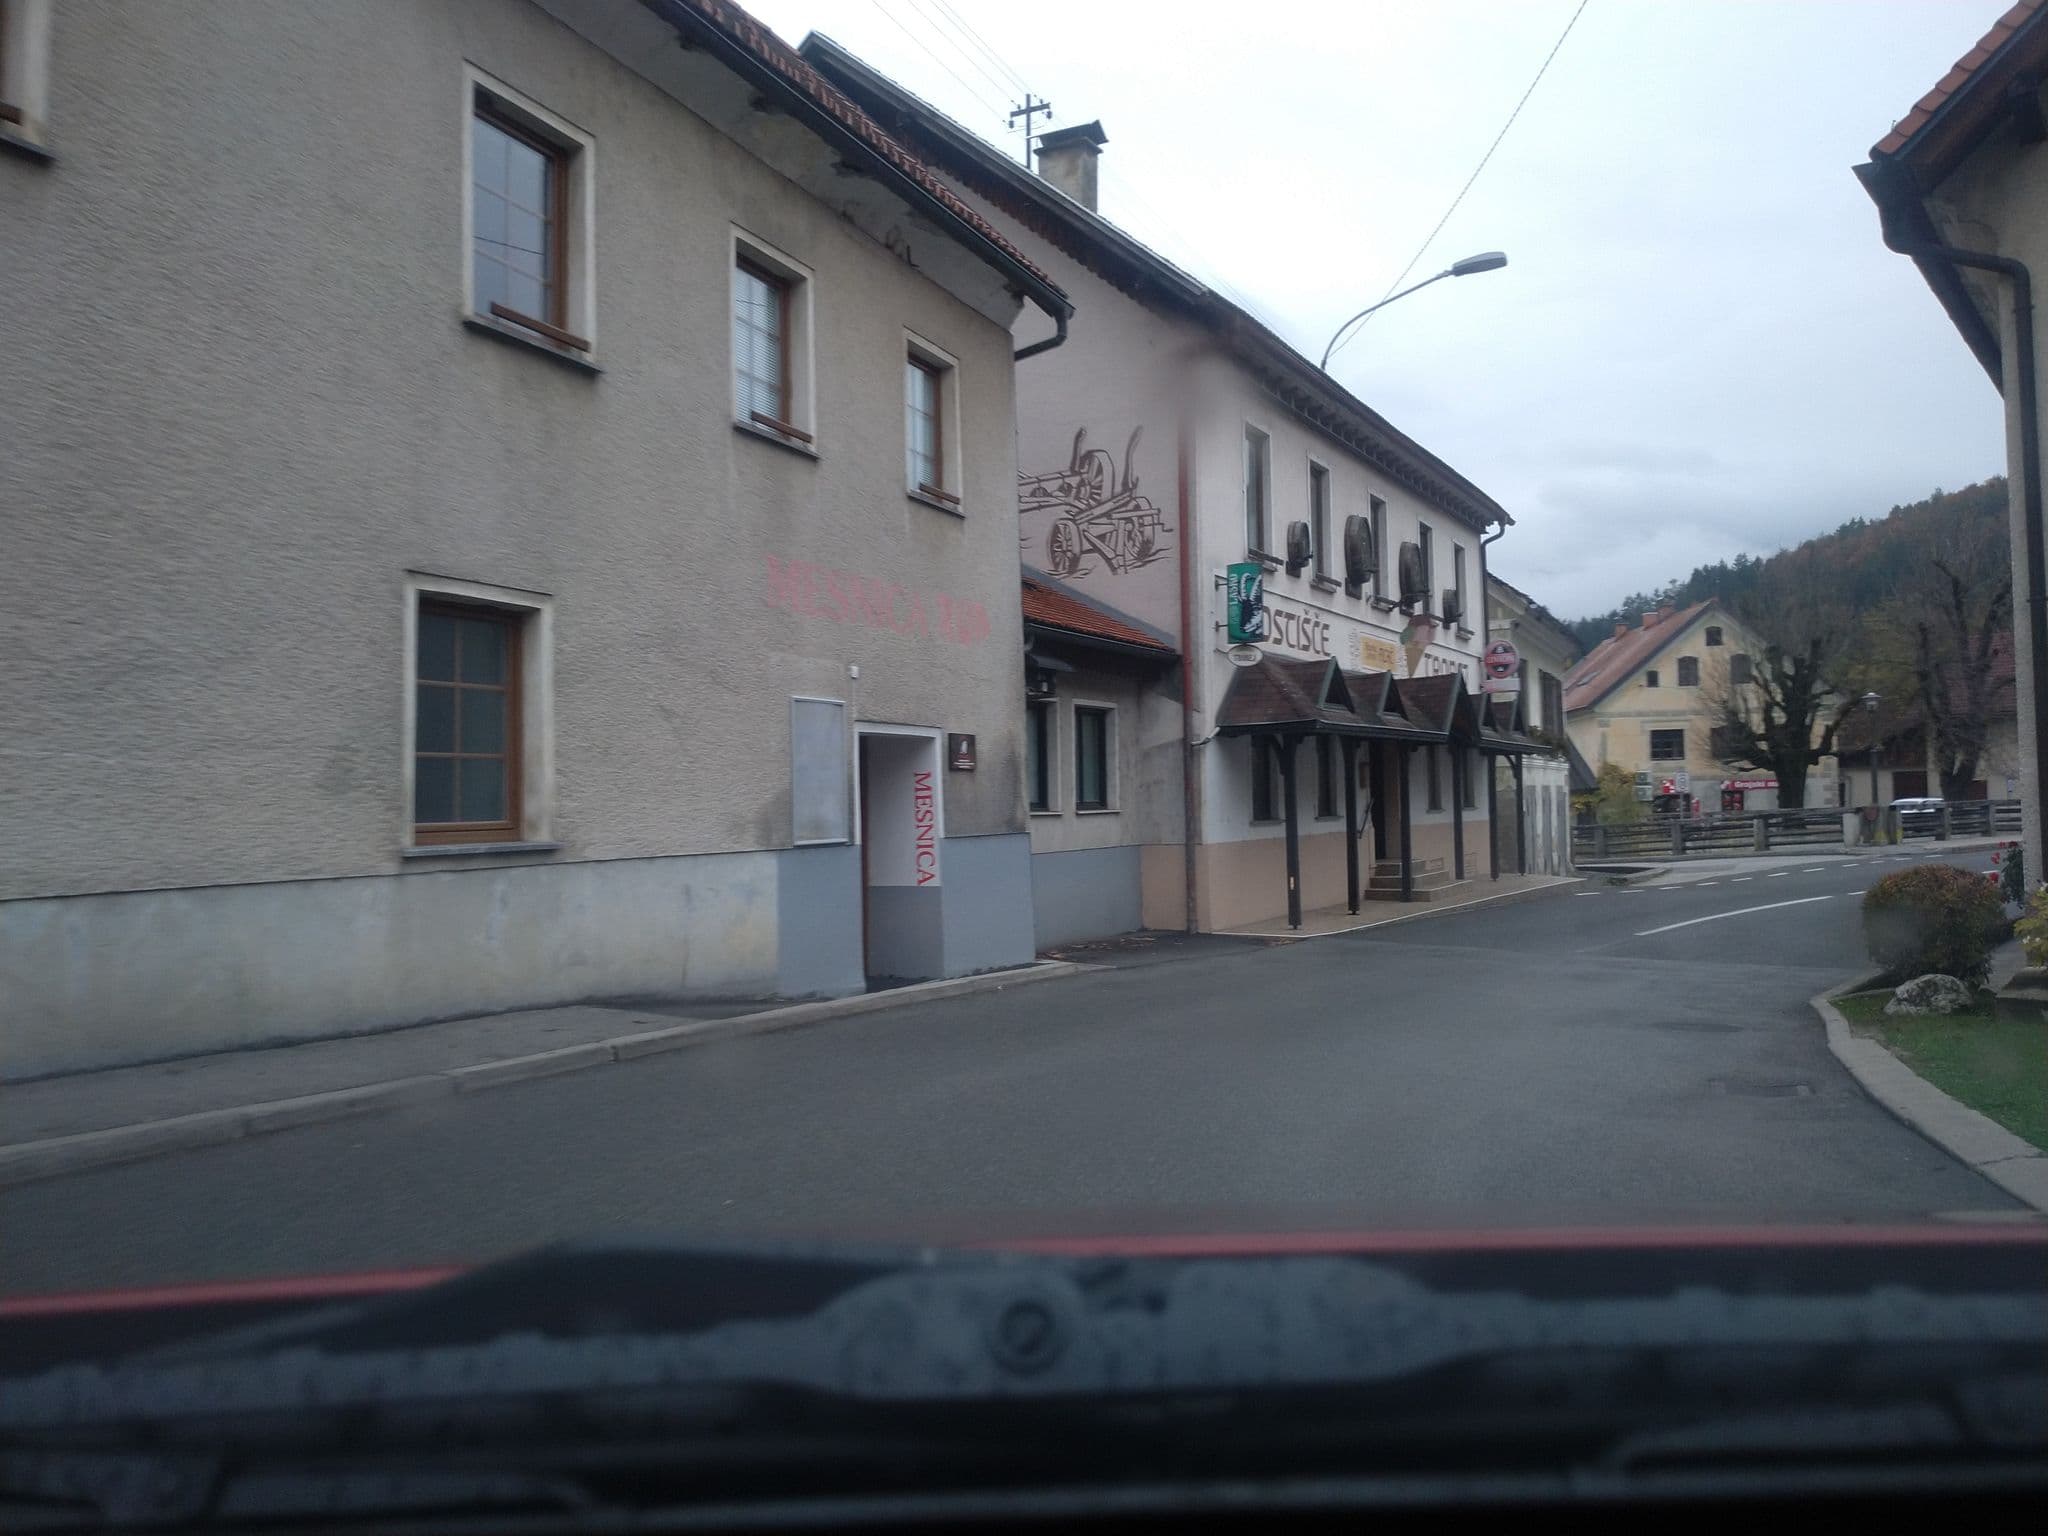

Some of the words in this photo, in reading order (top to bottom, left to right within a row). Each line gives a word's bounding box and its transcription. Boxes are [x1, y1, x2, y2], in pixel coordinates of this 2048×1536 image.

[767, 553, 929, 639] MESNICA
[1263, 605, 1332, 657] OSTIŠČE
[913, 771, 936, 886] MESNICA
